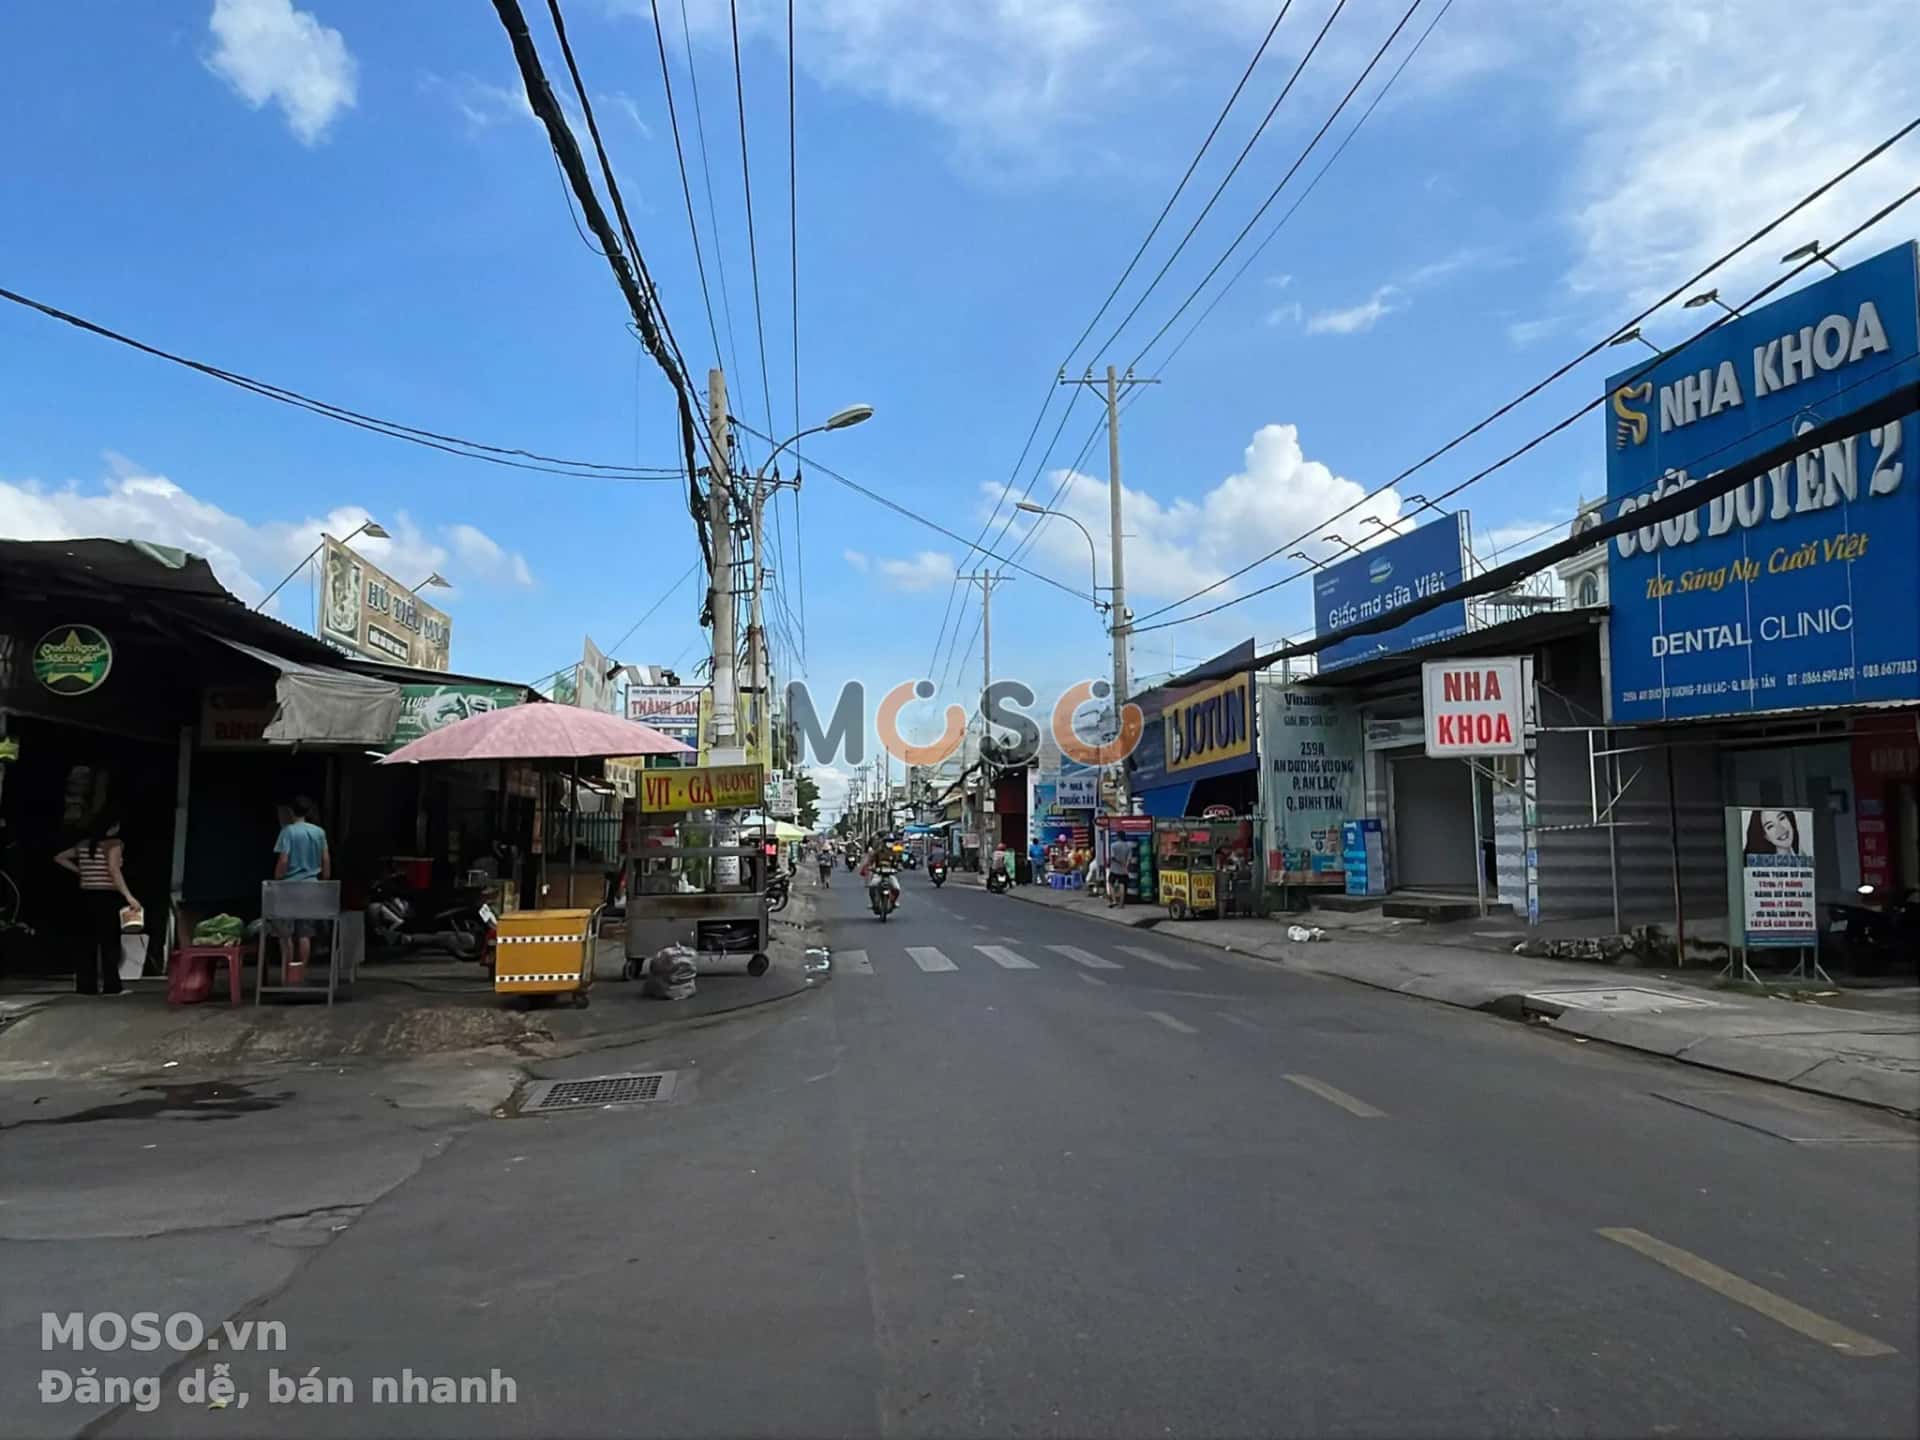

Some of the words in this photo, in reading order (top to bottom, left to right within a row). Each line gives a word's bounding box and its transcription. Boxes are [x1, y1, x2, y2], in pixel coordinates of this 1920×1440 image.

[1660, 361, 1744, 433] NHA
[1753, 301, 1890, 397] KHOA
[1868, 417, 1903, 496] 2
[1677, 567, 1727, 592] Sáng
[1768, 540, 1818, 575] Cười
[1823, 533, 1869, 563] Việt
[1328, 601, 1358, 629] Giấc
[1360, 594, 1382, 617] mơ
[1385, 584, 1411, 611] sữa
[1651, 622, 1752, 657] DENTAL
[1760, 604, 1854, 641] CLINIC
[1443, 670, 1502, 703] NHA
[1184, 685, 1246, 760] JOTUN
[1438, 713, 1512, 745] KHOA
[645, 776, 672, 810] VỊT
[688, 769, 715, 805] GÀ
